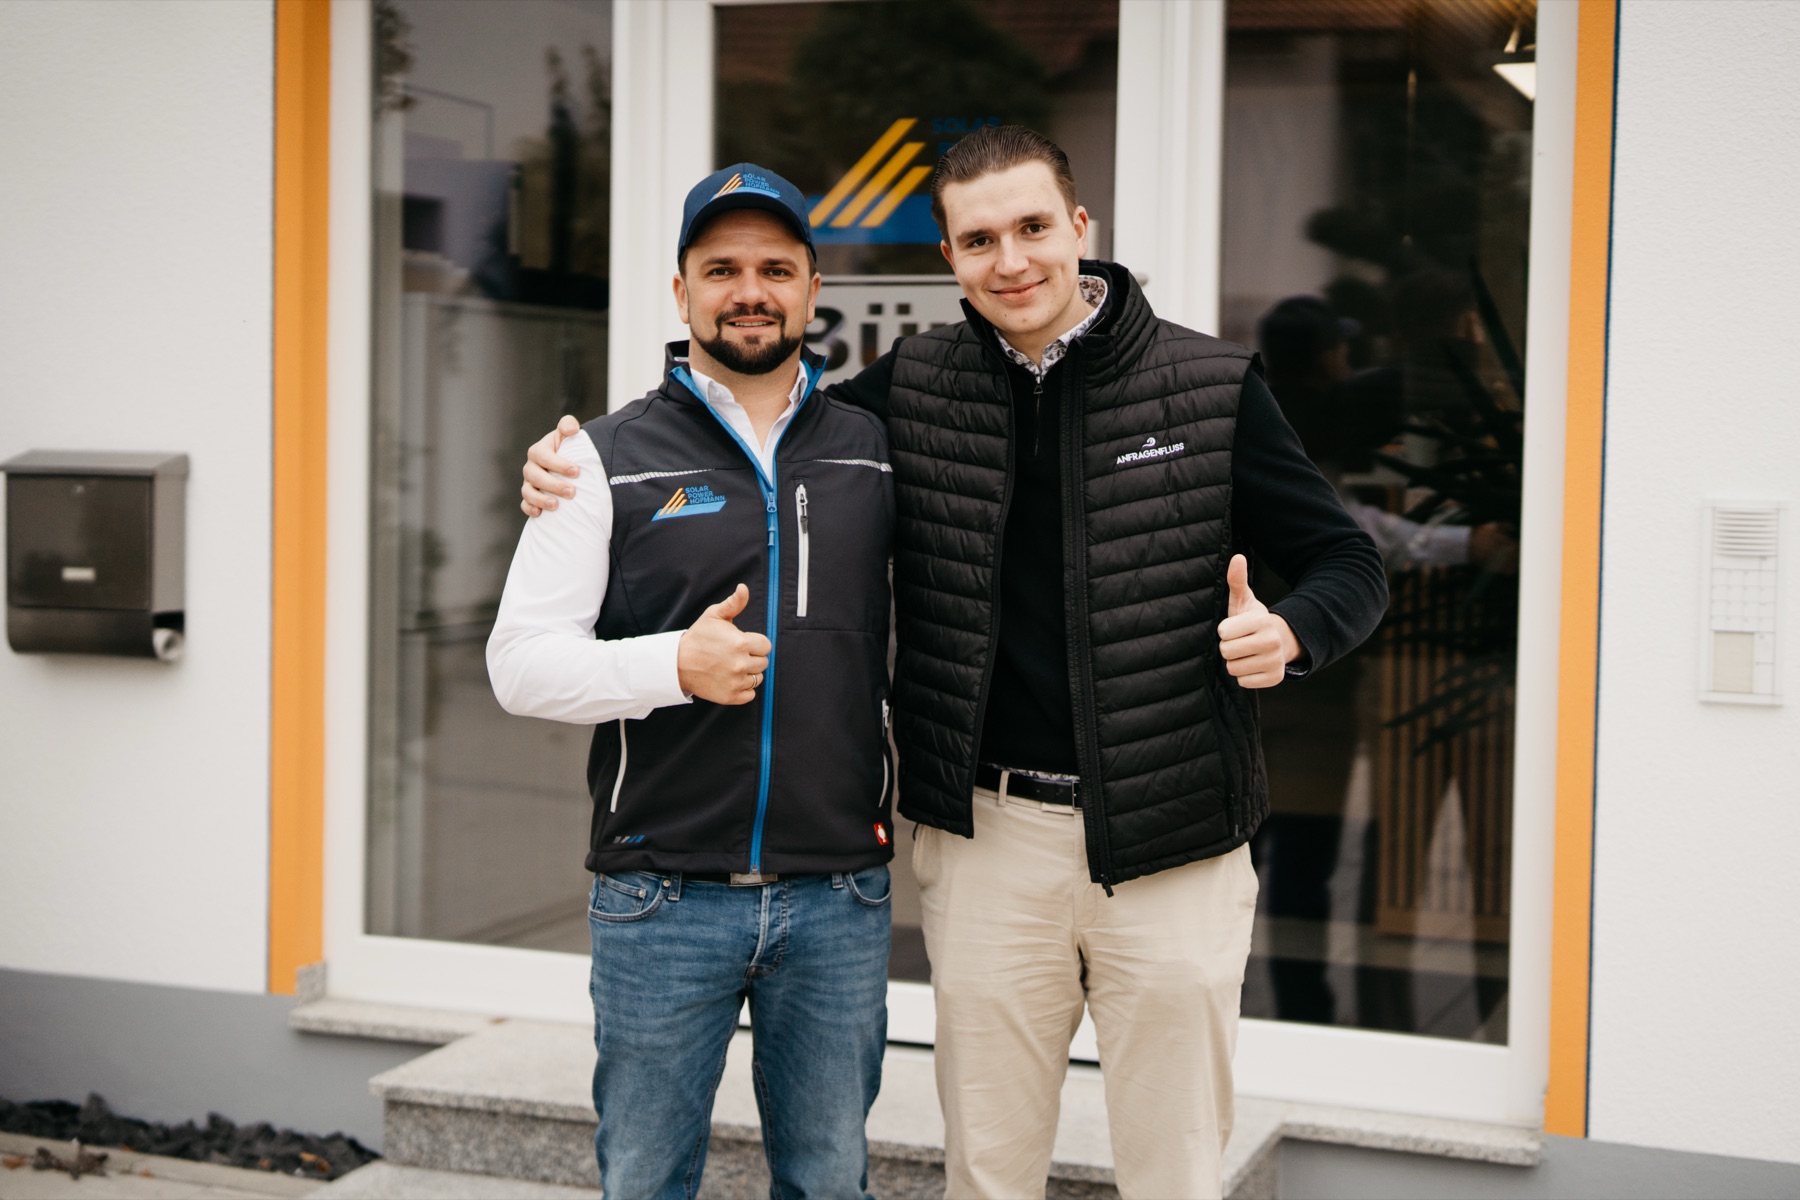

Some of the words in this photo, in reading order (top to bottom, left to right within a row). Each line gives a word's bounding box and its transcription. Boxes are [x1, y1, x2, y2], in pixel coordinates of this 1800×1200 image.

[742, 173, 766, 182] SOLAR
[744, 178, 770, 187] POWER
[1116, 442, 1185, 464] ANFRAGENFLUSS
[685, 485, 709, 494] SOLAR
[687, 490, 714, 499] POWER
[689, 495, 725, 504] HOFMANN
